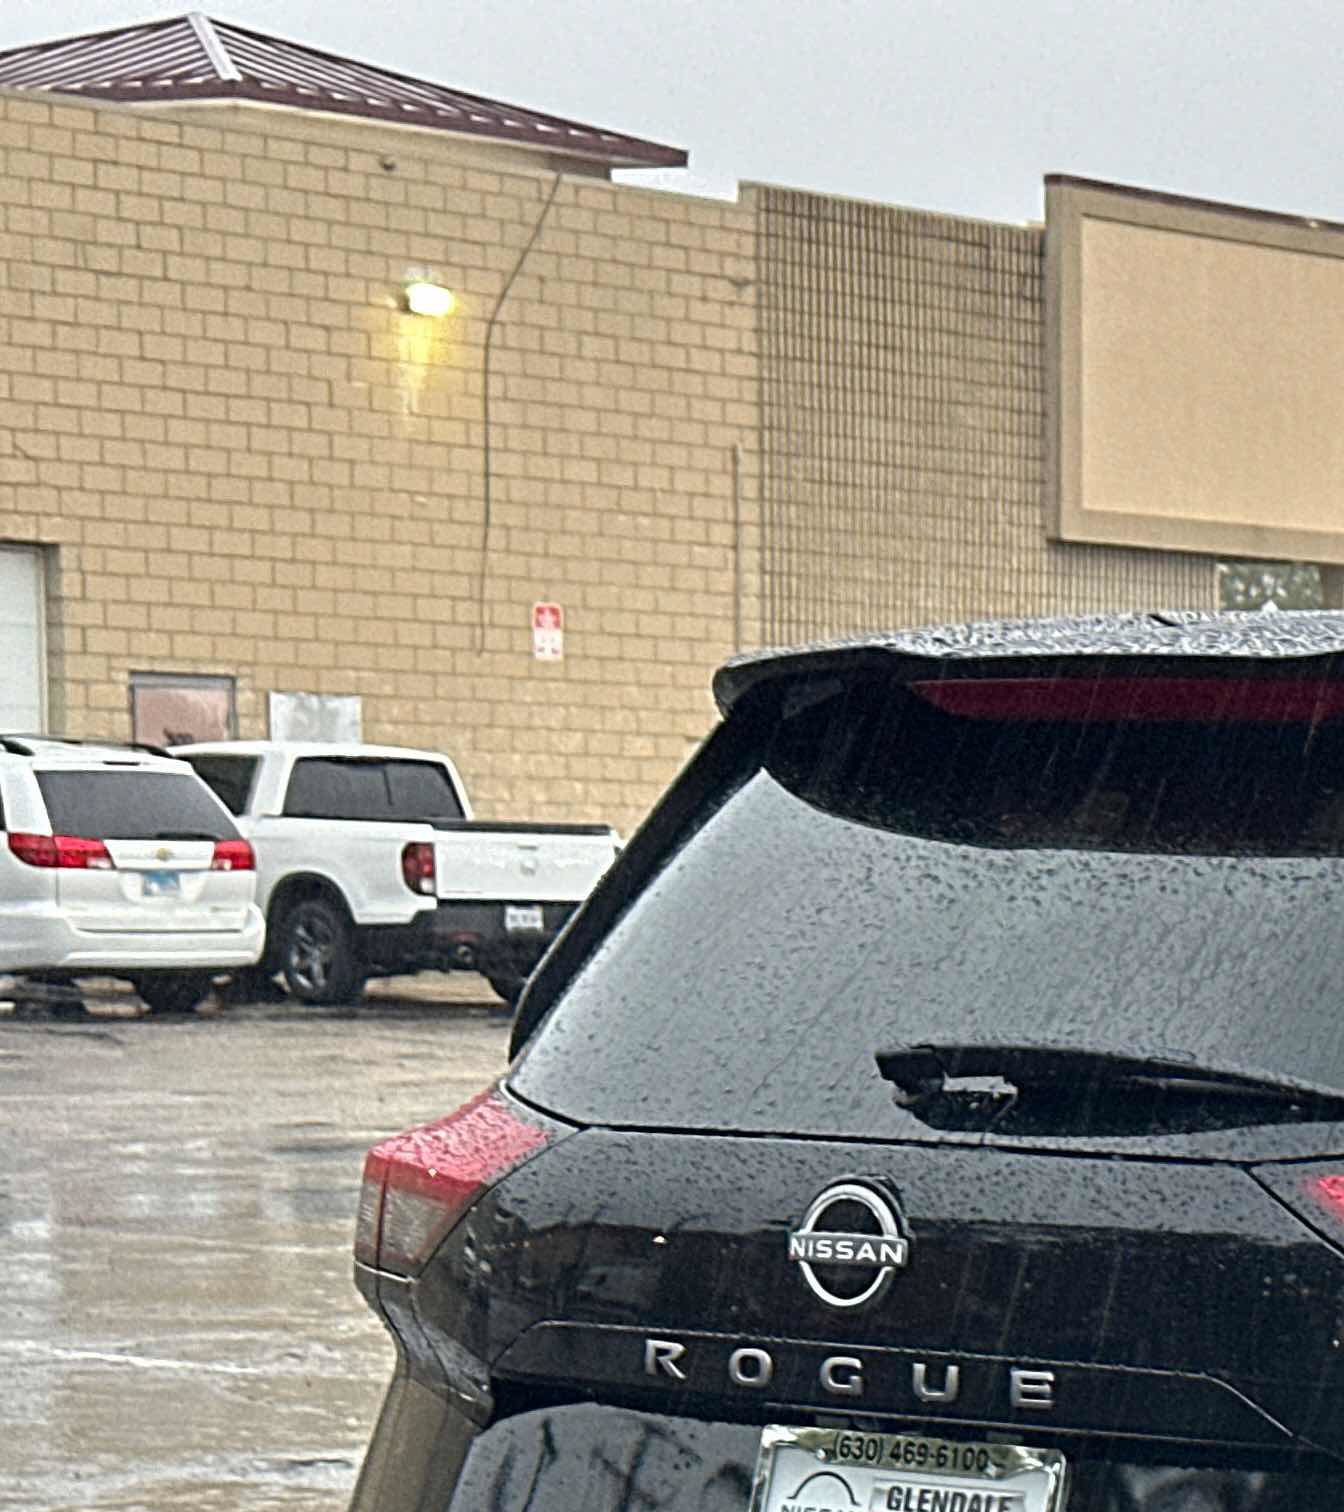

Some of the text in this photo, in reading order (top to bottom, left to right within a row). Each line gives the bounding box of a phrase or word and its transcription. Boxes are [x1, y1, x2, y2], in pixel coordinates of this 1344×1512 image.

[789, 1232, 905, 1264] NISSAN
[644, 1339, 1055, 1410] ROGUE
[834, 1432, 991, 1473] (630) 469-6100
